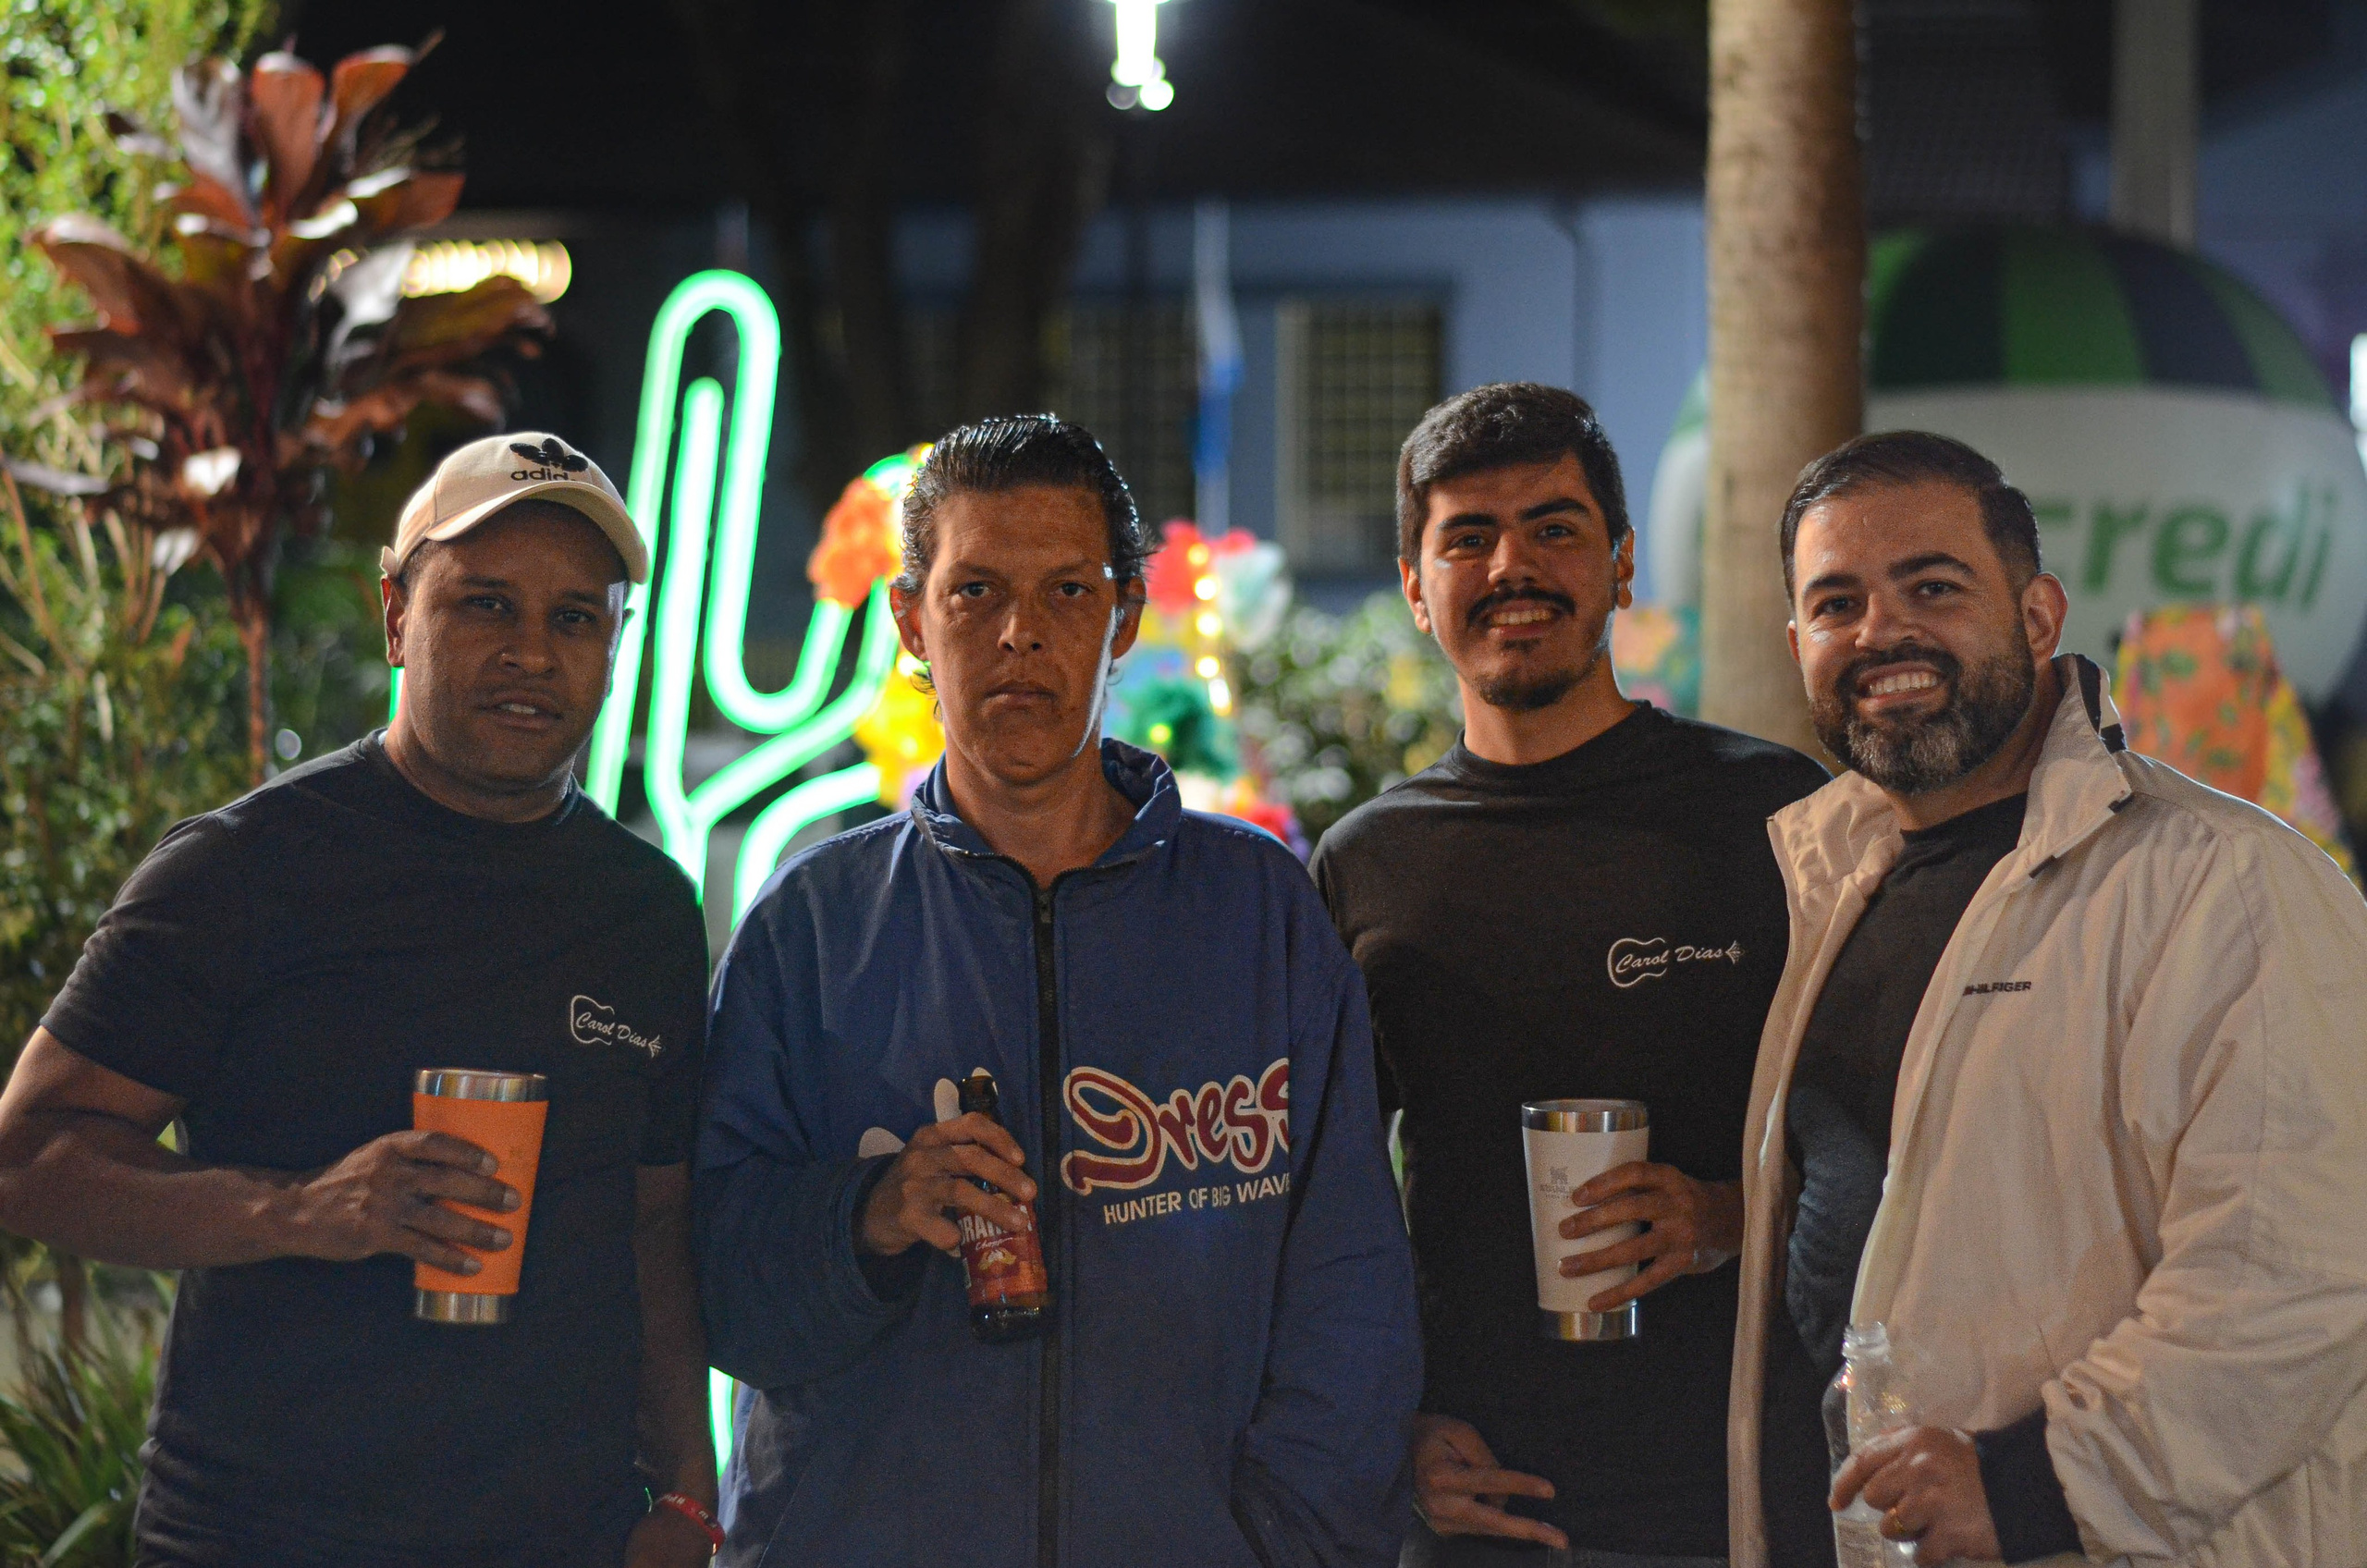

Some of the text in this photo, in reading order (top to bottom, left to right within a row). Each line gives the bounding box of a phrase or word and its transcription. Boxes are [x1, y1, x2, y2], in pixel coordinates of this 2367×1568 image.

[510, 467, 576, 481] adid
[1615, 945, 1723, 974] Carol Dias
[1971, 981, 2032, 995] HILFIGER
[576, 1011, 648, 1047] Carol Dias
[1103, 1191, 1182, 1225] HUNTER
[1188, 1187, 1208, 1209] OF
[1211, 1185, 1231, 1207] BIG
